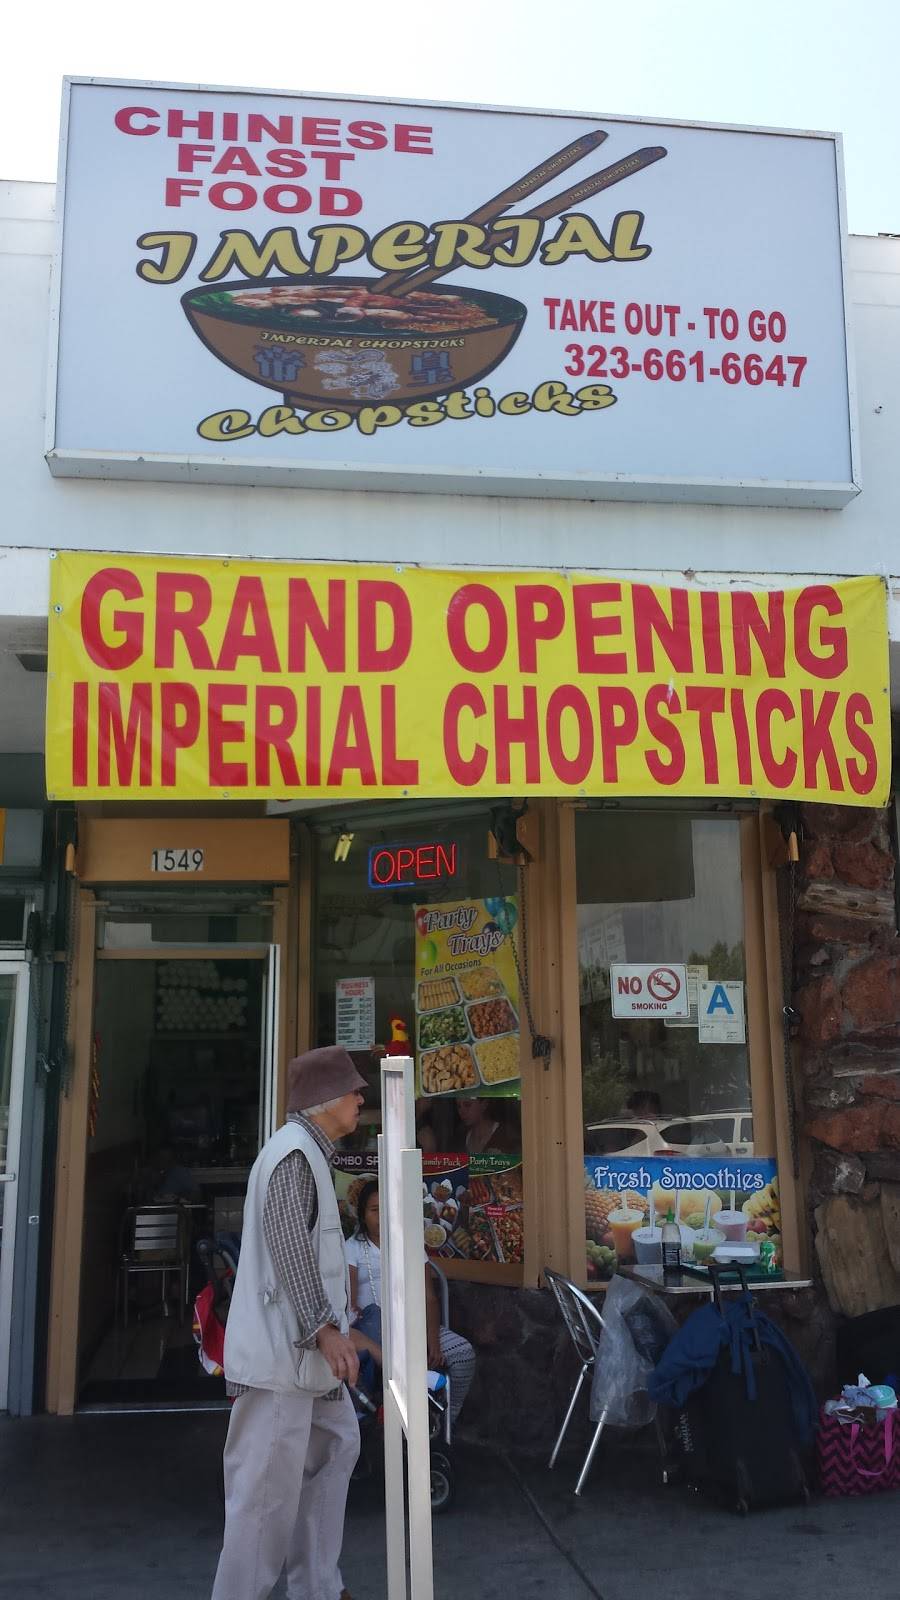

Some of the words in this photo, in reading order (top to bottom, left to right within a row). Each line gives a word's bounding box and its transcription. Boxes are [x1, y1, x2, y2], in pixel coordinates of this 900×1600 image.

[114, 106, 434, 155] CHINESE
[177, 143, 355, 181] FAST
[165, 178, 363, 217] FOOD
[136, 210, 652, 284] IMPERIAL
[543, 297, 616, 333] TAKE
[624, 302, 681, 336] OUT
[703, 307, 739, 340] TO
[748, 310, 787, 343] GO
[260, 331, 353, 348] IMPERIAL
[358, 337, 465, 349] CHOPSTICKS
[564, 343, 808, 388] 323-661-6647
[196, 380, 618, 442] Chopsticks
[80, 567, 413, 673] GRAND
[446, 582, 849, 680] OPENING
[72, 681, 419, 787] IMPERIAL
[442, 682, 879, 795] CHOPSTICKS
[152, 849, 204, 871] 1549
[373, 843, 457, 883] OPEN
[423, 906, 479, 933] Party
[447, 930, 504, 957] Trays
[420, 967, 433, 977] For
[444, 959, 482, 972] Occasions
[617, 976, 643, 995] NO
[706, 983, 735, 1015] A
[631, 1002, 668, 1010] SMOKING
[332, 1155, 363, 1166] OMBO
[443, 1157, 462, 1167] Pack
[469, 1156, 489, 1168] Party
[490, 1156, 511, 1169] Trays
[594, 1165, 651, 1190] Fresh
[661, 1166, 764, 1191] Smoothies
